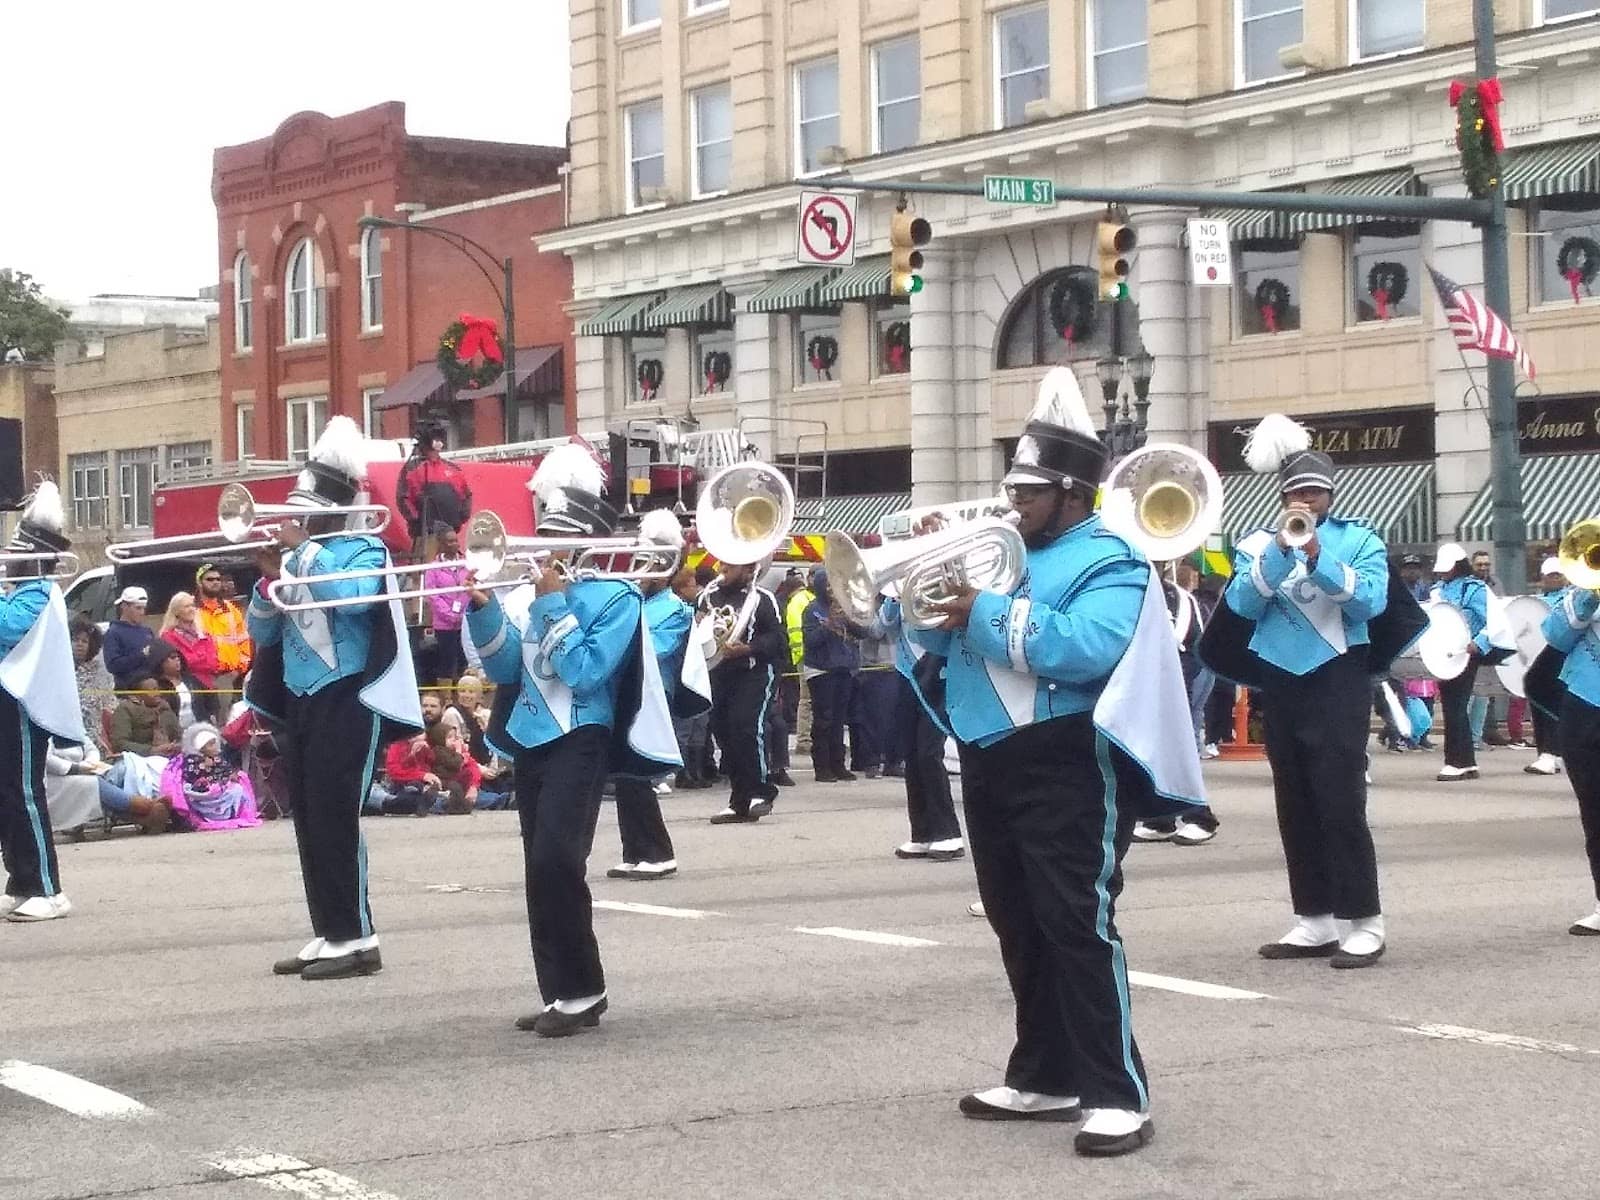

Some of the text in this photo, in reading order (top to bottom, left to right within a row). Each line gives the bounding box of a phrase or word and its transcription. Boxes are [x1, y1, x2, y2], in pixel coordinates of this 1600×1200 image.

[988, 179, 1050, 202] MAIN ST
[1200, 224, 1217, 236] NO
[1195, 252, 1227, 264] ON RED
[1518, 411, 1585, 440] Anna
[1312, 425, 1405, 452] AZA ATM
